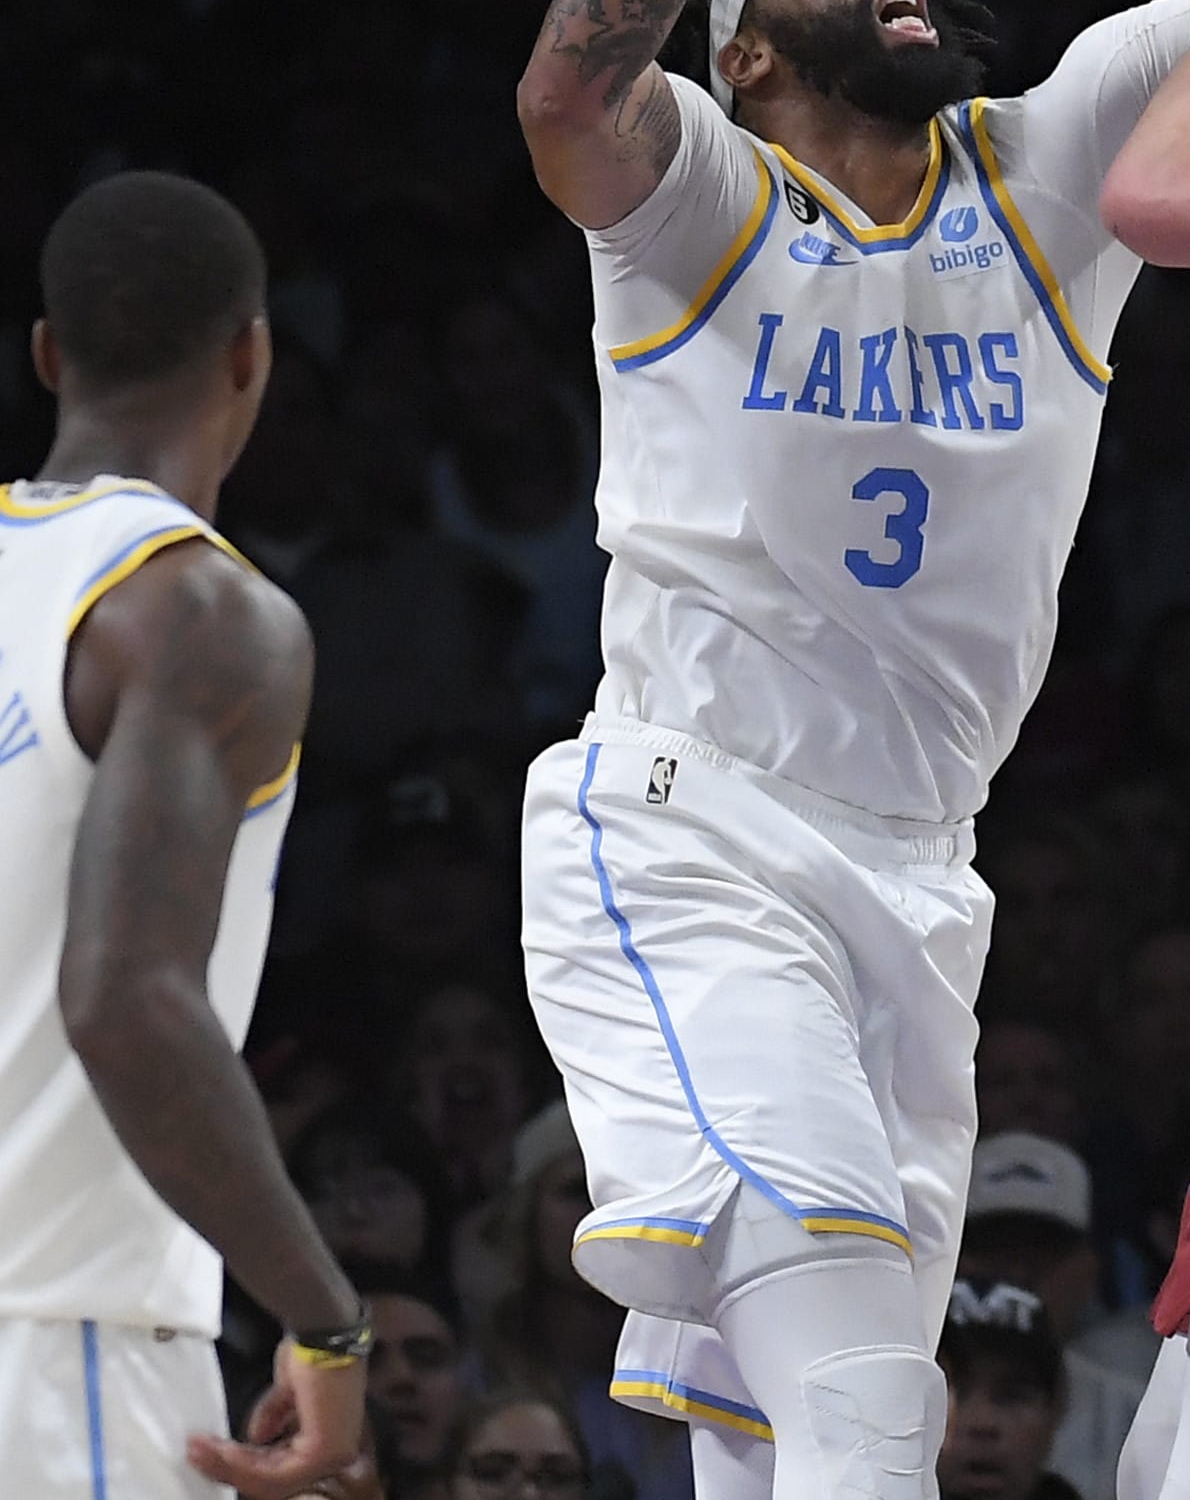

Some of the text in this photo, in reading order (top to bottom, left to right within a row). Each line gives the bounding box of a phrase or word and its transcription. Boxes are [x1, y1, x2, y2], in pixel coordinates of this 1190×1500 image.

[929, 241, 1004, 273] bibigo
[742, 313, 1024, 431] LAKERS
[845, 467, 930, 589] 3
